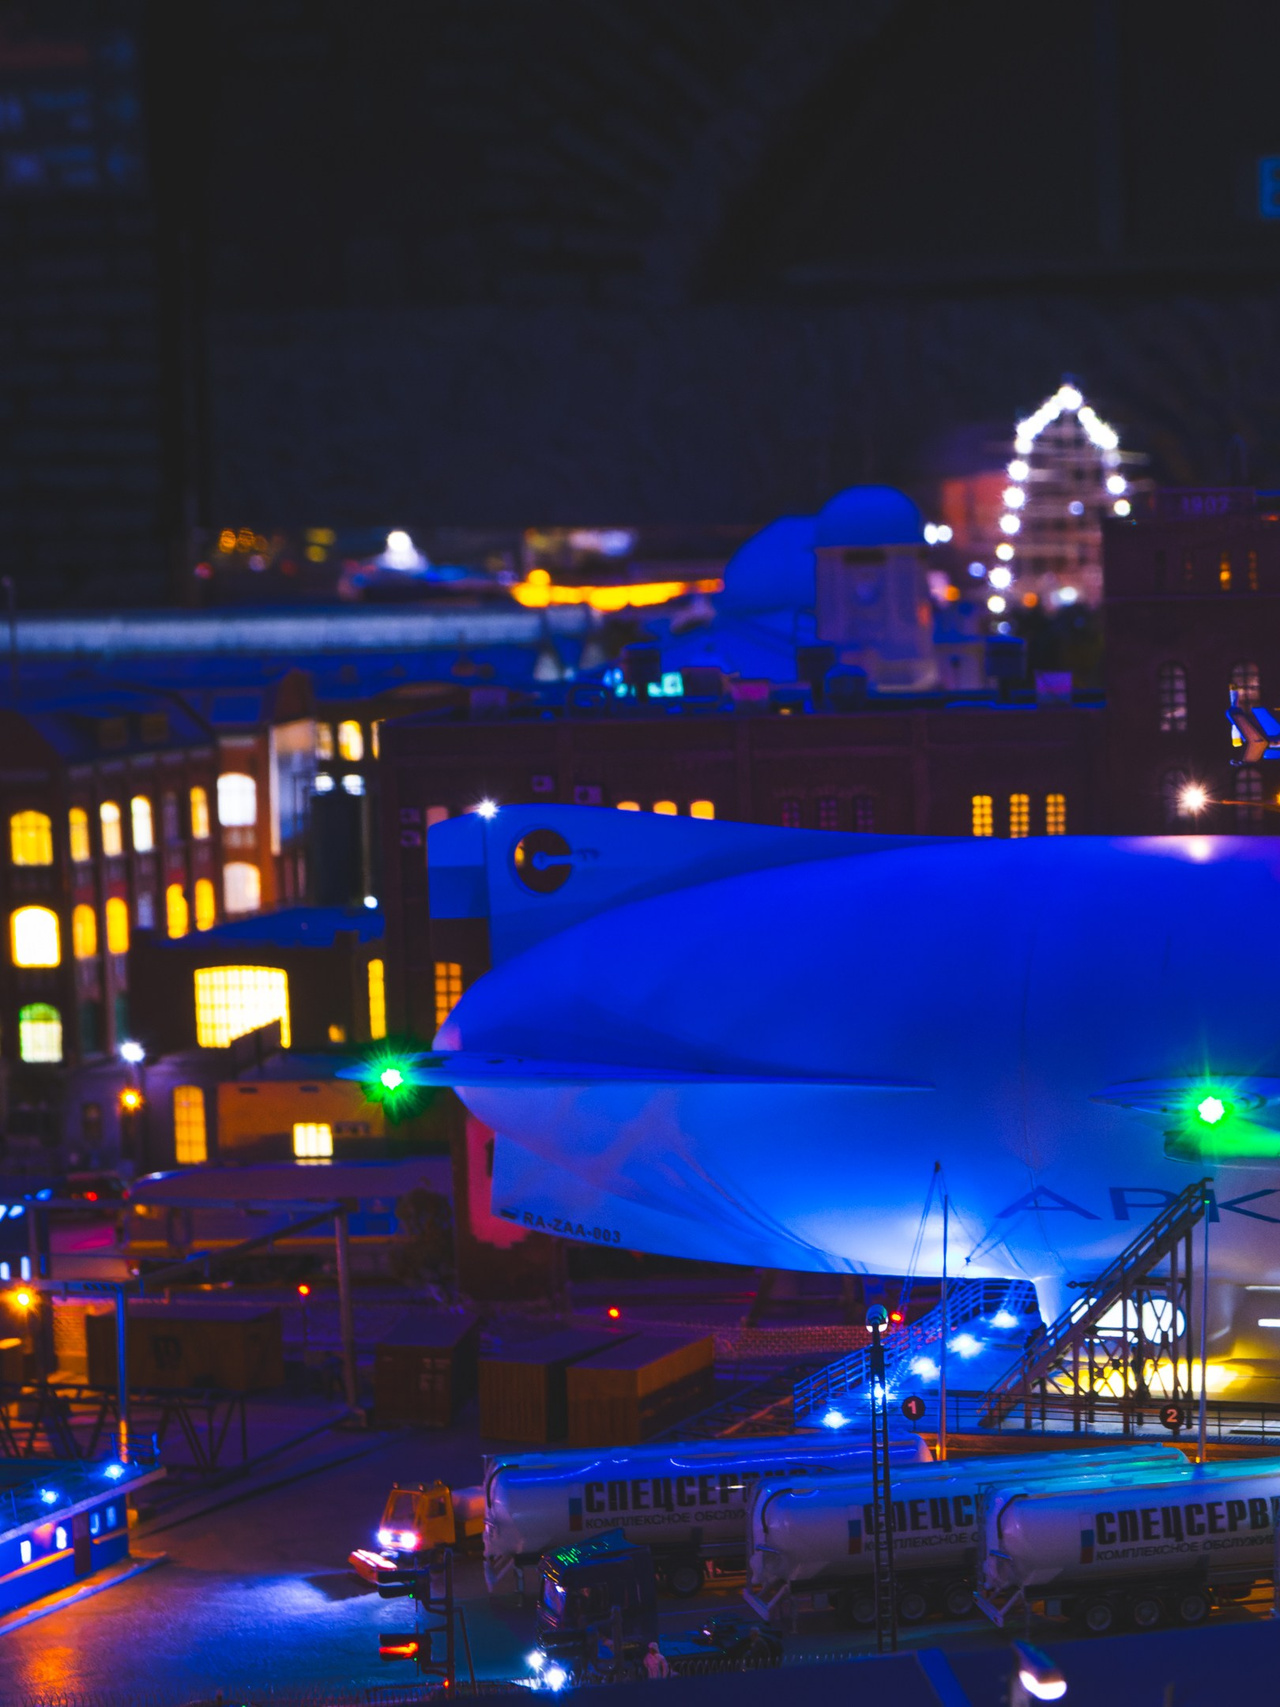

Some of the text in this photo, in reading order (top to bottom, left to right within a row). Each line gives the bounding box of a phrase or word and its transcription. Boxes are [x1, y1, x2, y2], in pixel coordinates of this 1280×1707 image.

[523, 1211, 621, 1242] RA-ZAA-003
[907, 1400, 917, 1415] 1
[1166, 1408, 1178, 1423] 2
